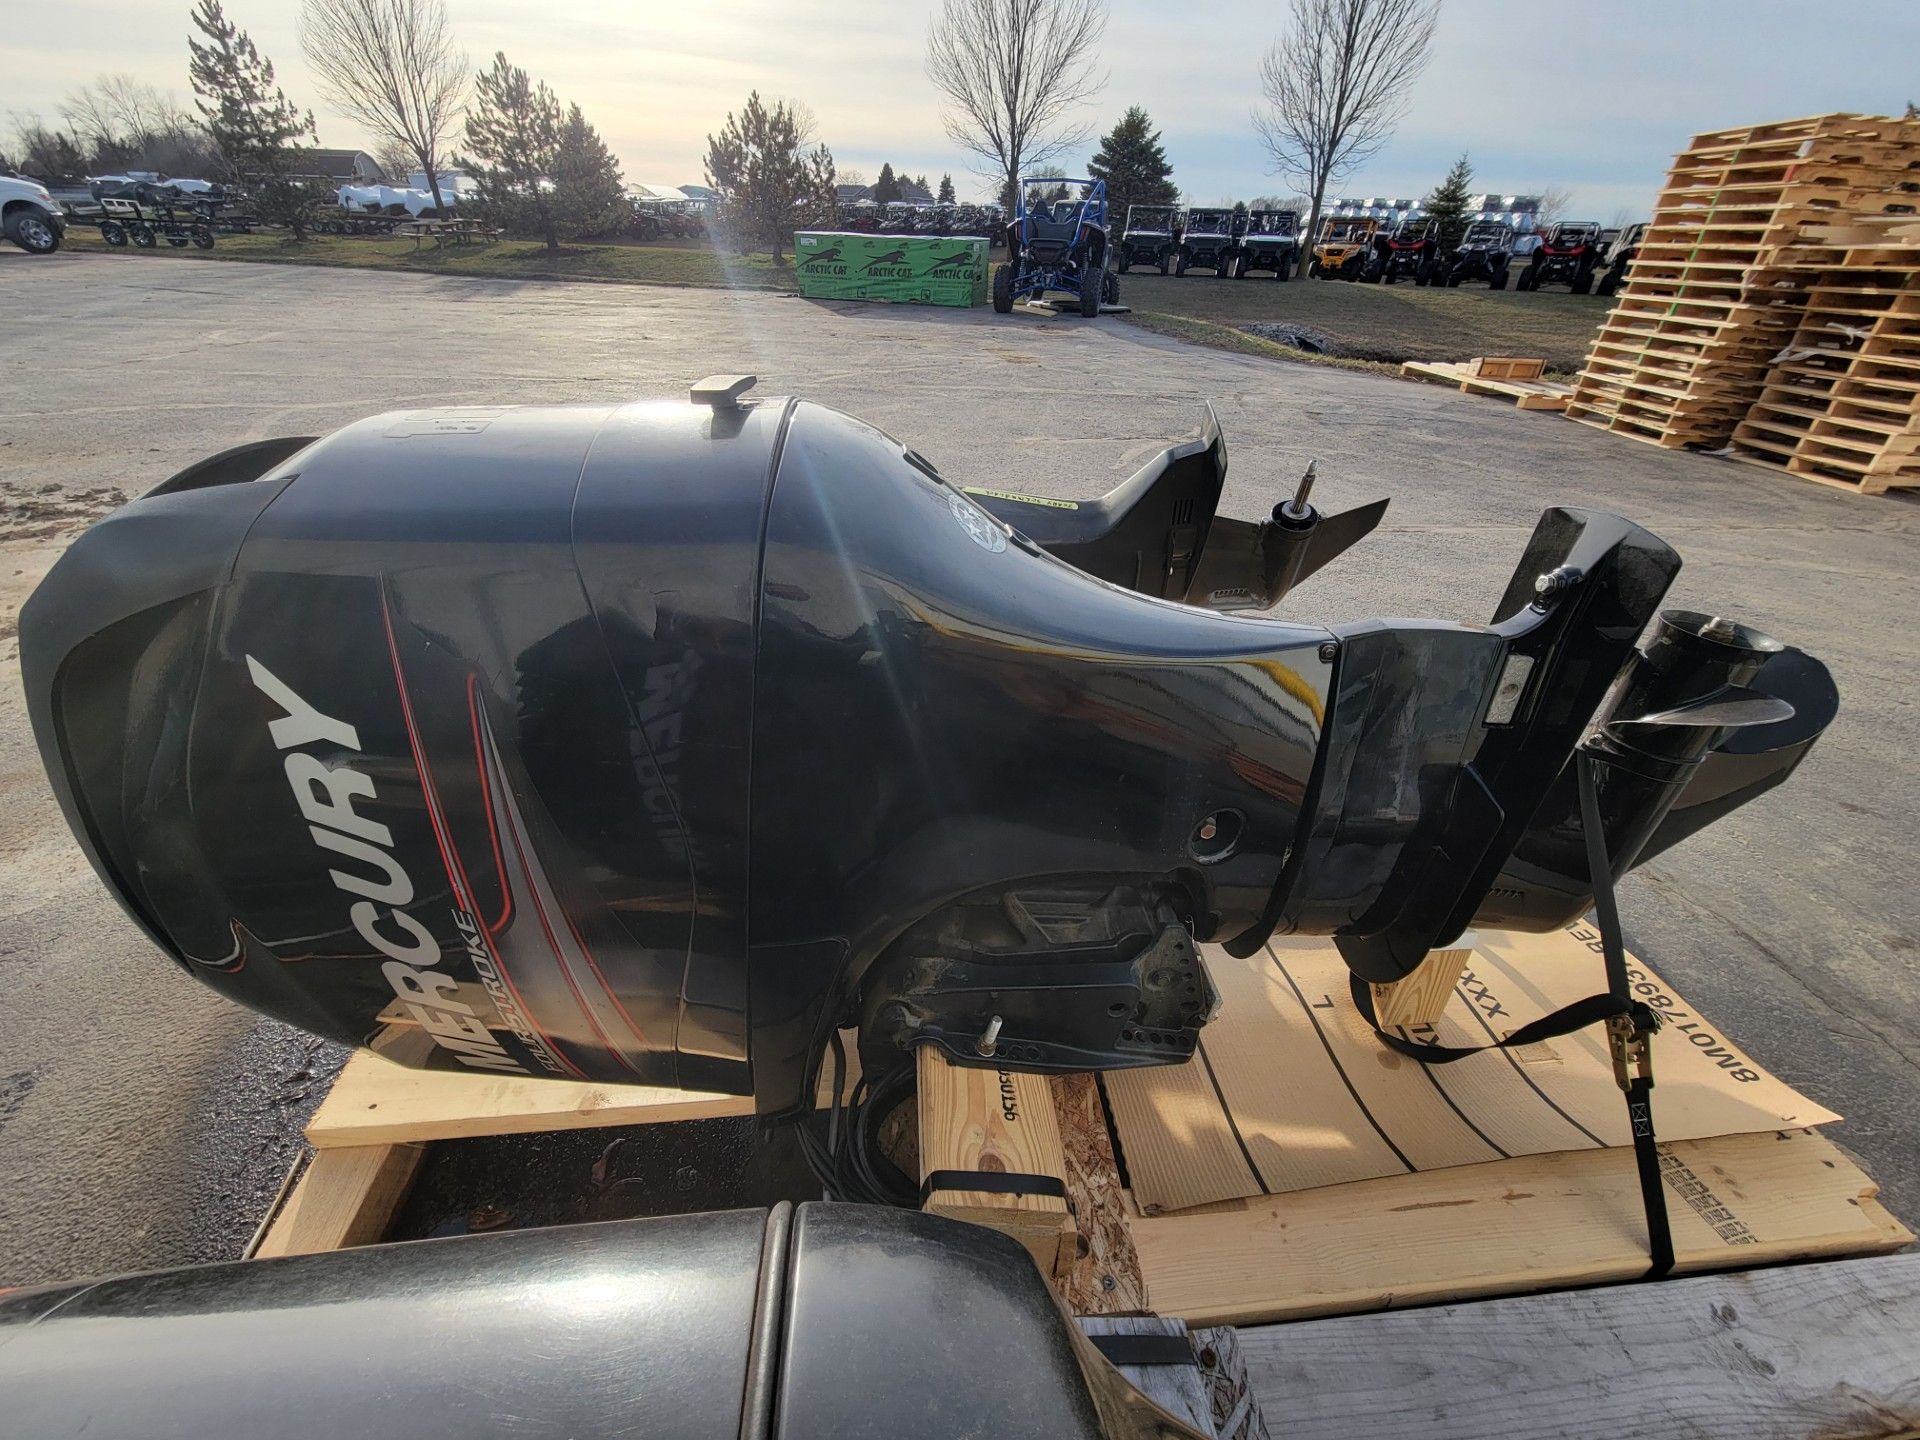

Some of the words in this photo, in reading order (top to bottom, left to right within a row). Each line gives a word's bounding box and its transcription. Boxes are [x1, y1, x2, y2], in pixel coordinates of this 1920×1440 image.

[805, 264, 832, 275] ARCTIC
[833, 264, 848, 276] CAT
[867, 267, 896, 278] ARCTIC
[896, 267, 912, 279] CAT
[932, 269, 962, 279] ARCTIC
[246, 654, 531, 1074] MERCURY
[1460, 966, 1510, 1018] XXX
[1625, 962, 1760, 1083] 8M017893
